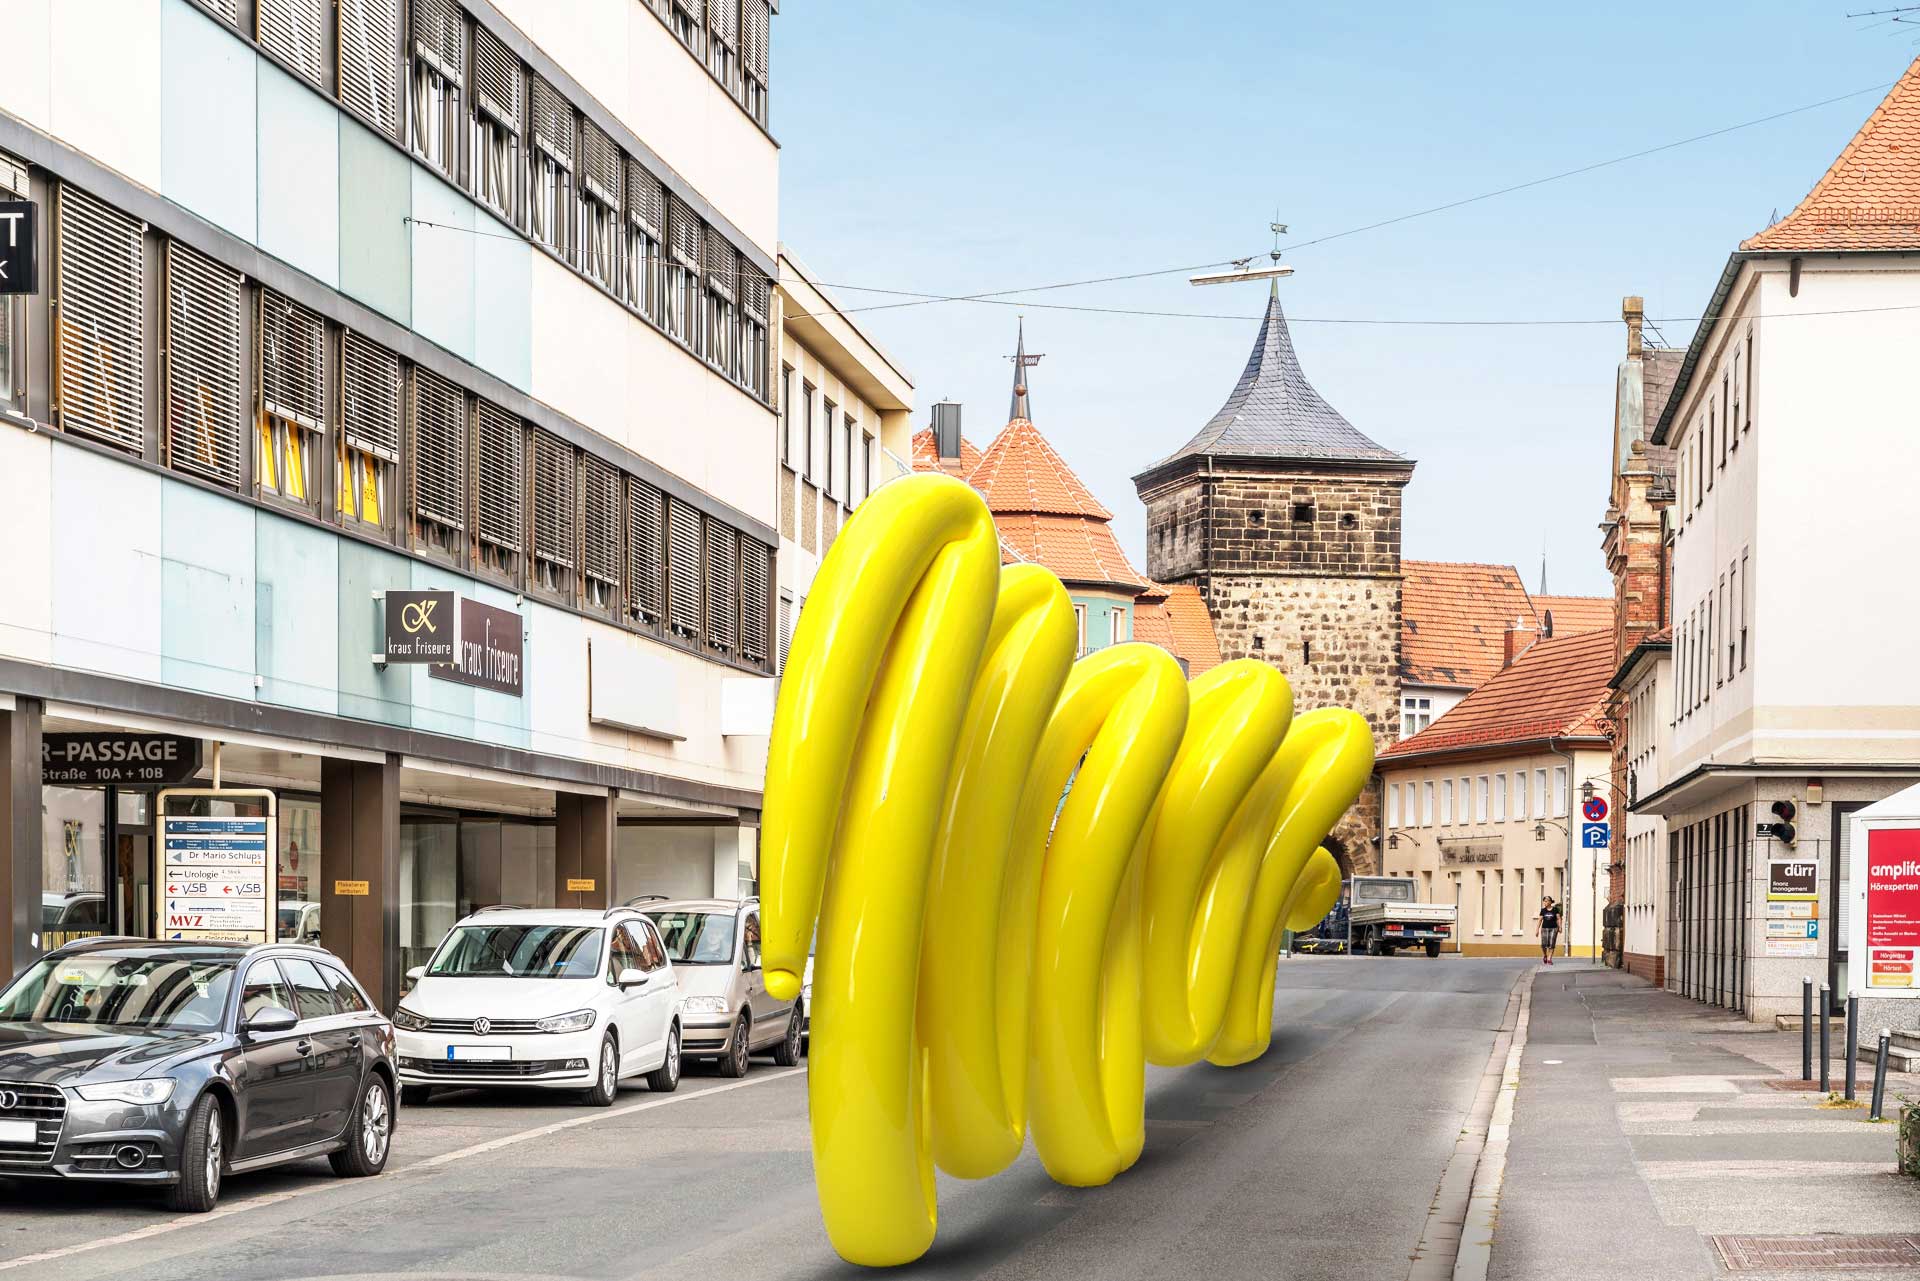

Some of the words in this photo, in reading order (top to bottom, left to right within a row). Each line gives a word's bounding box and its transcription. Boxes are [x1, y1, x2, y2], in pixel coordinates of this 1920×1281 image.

[388, 636, 412, 655] kraus
[415, 636, 451, 655] friseure
[485, 617, 519, 686] friseure
[95, 767, 122, 780] 10A
[126, 771, 134, 779] +
[138, 767, 164, 779] 10B
[1762, 824, 1769, 832] 7
[1590, 831, 1601, 846] P
[202, 851, 227, 860] Mario
[228, 851, 262, 865] Schlups
[184, 869, 219, 880] Urologie
[1784, 863, 1815, 877] dürr
[182, 883, 207, 895] VSB
[236, 883, 261, 896] VSB
[1870, 883, 1919, 892] Hörexperten
[169, 915, 203, 927] MVZ
[1808, 923, 1817, 936] P
